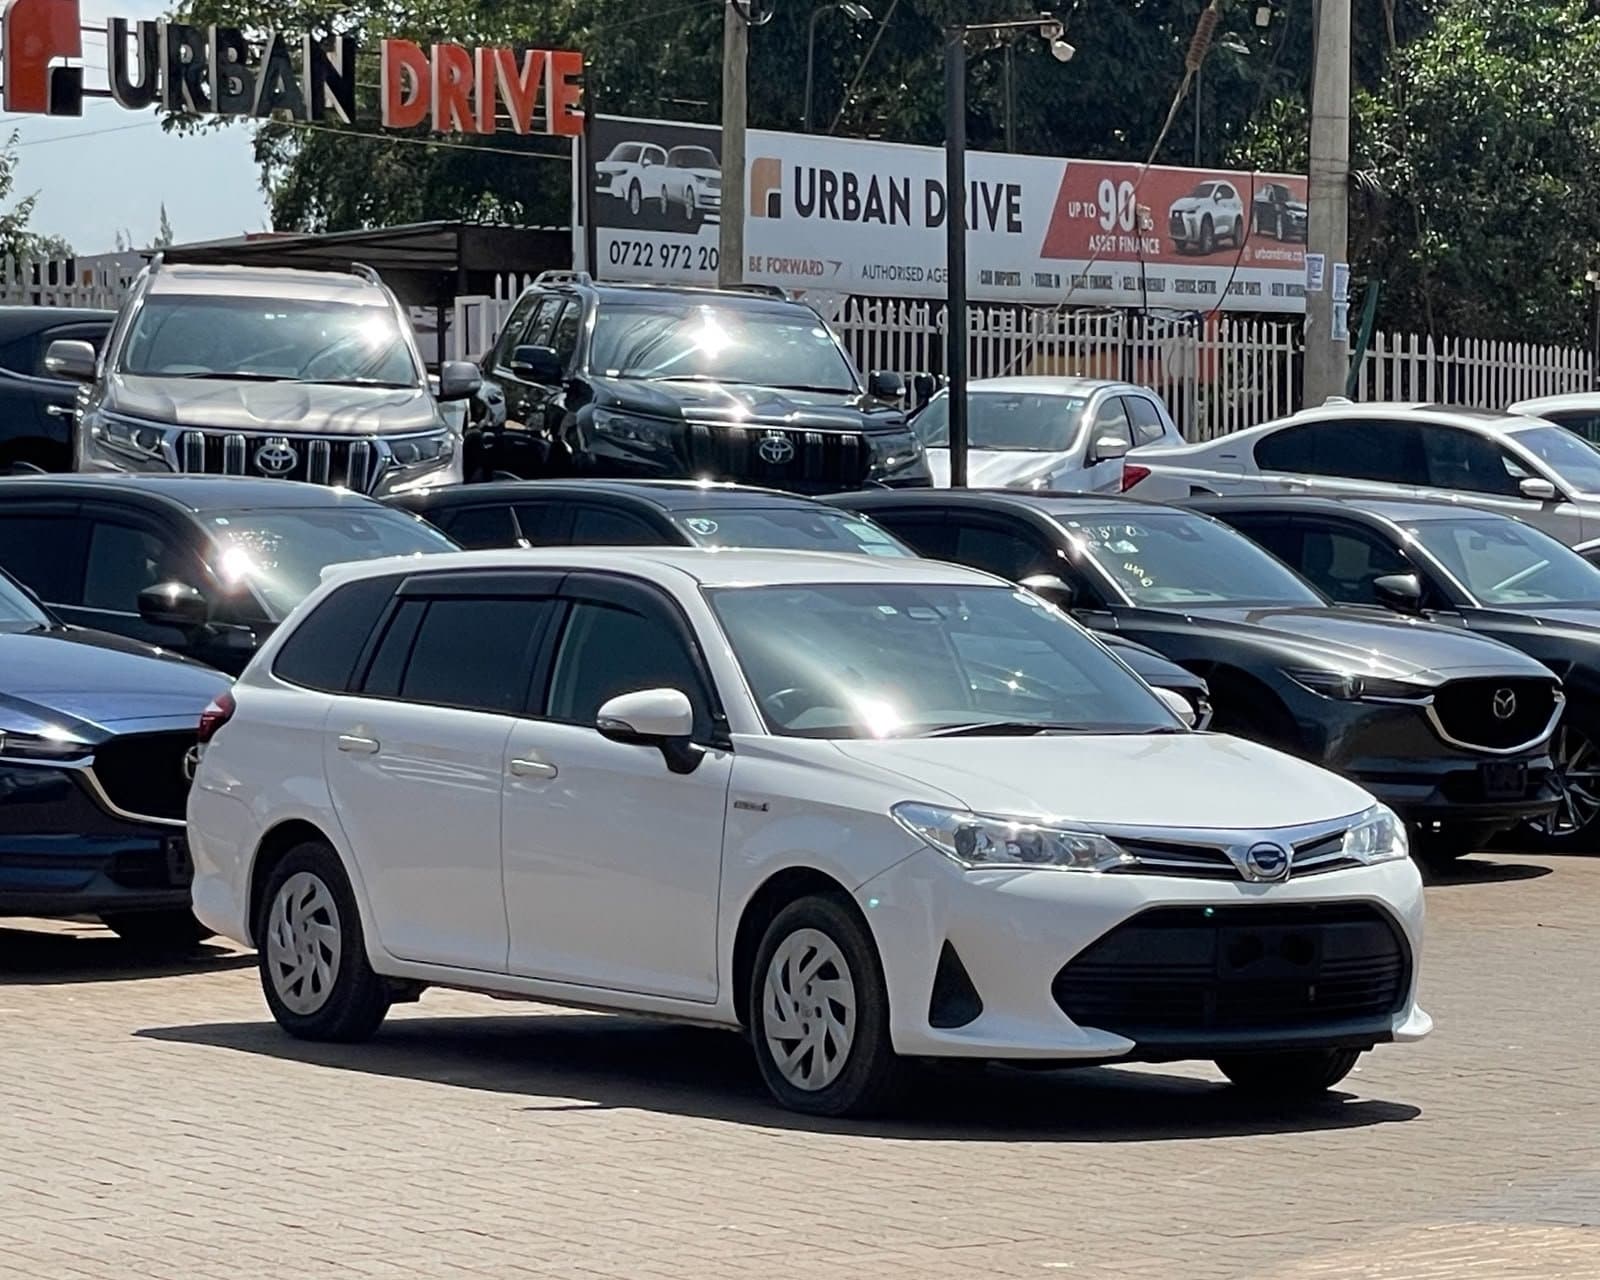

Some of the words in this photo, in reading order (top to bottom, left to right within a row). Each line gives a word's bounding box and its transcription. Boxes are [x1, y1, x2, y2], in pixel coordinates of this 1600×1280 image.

[107, 16, 356, 124] URBAN
[381, 38, 586, 136] DRIVE
[794, 165, 911, 227] URBAN
[925, 178, 1022, 234] DIVE
[1068, 201, 1081, 218] UP
[1082, 202, 1097, 218] TO
[1088, 234, 1117, 253] ASSET
[1119, 236, 1160, 255] FINANCE
[609, 240, 654, 268] 0722
[659, 243, 693, 269] 972
[698, 246, 719, 272] 20
[749, 255, 763, 273] BE
[766, 256, 825, 277] FORWARD
[862, 264, 924, 282] AUTHORISED
[926, 267, 948, 284] AGE
